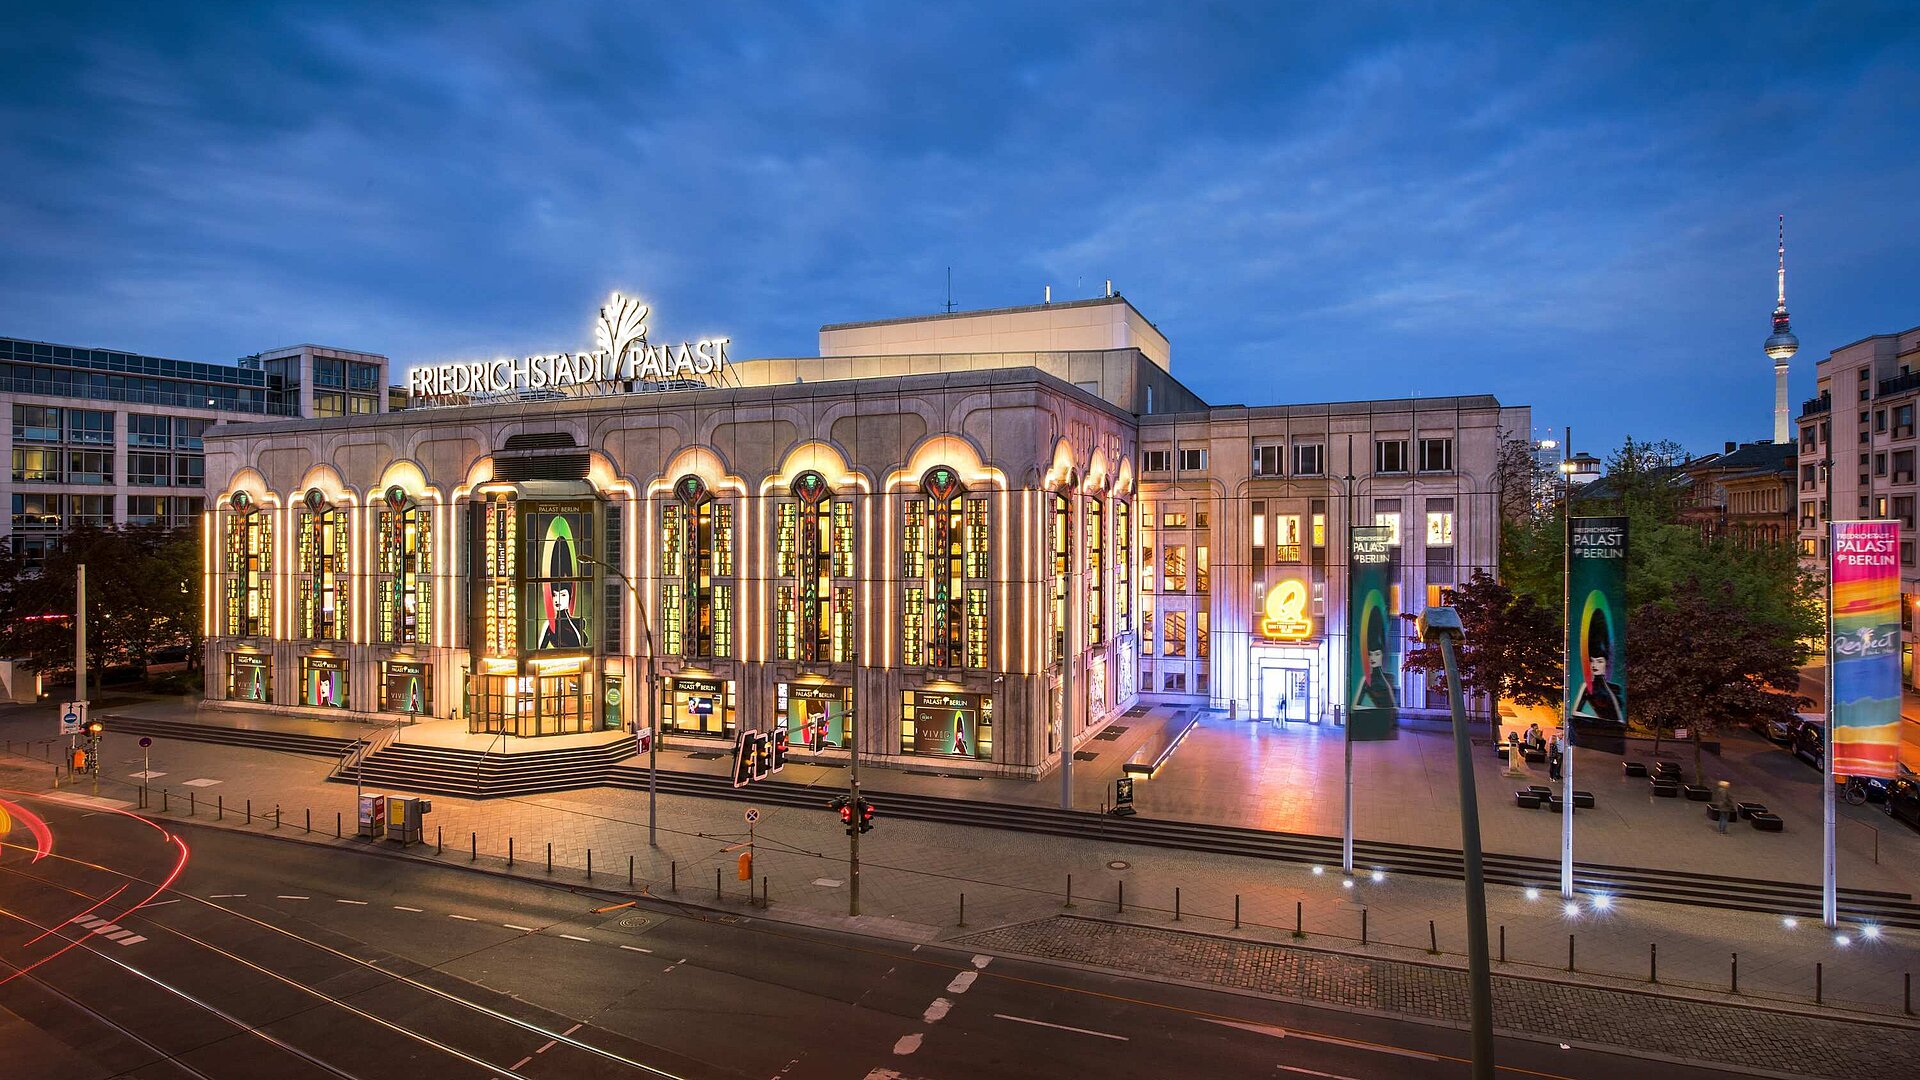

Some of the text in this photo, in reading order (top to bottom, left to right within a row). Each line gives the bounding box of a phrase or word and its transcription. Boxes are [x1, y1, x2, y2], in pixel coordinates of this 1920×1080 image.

[409, 338, 730, 397] FRIEDRICHSTADT PALAST
[1573, 534, 1624, 546] PALAST
[1836, 540, 1895, 552] PALAST
[1353, 542, 1389, 553] PALAST
[1583, 548, 1623, 558] BERLIN
[1360, 554, 1390, 564] BERLIN
[1848, 554, 1895, 566] BERLIN
[498, 589, 506, 599] in
[1834, 630, 1898, 657] Respect
